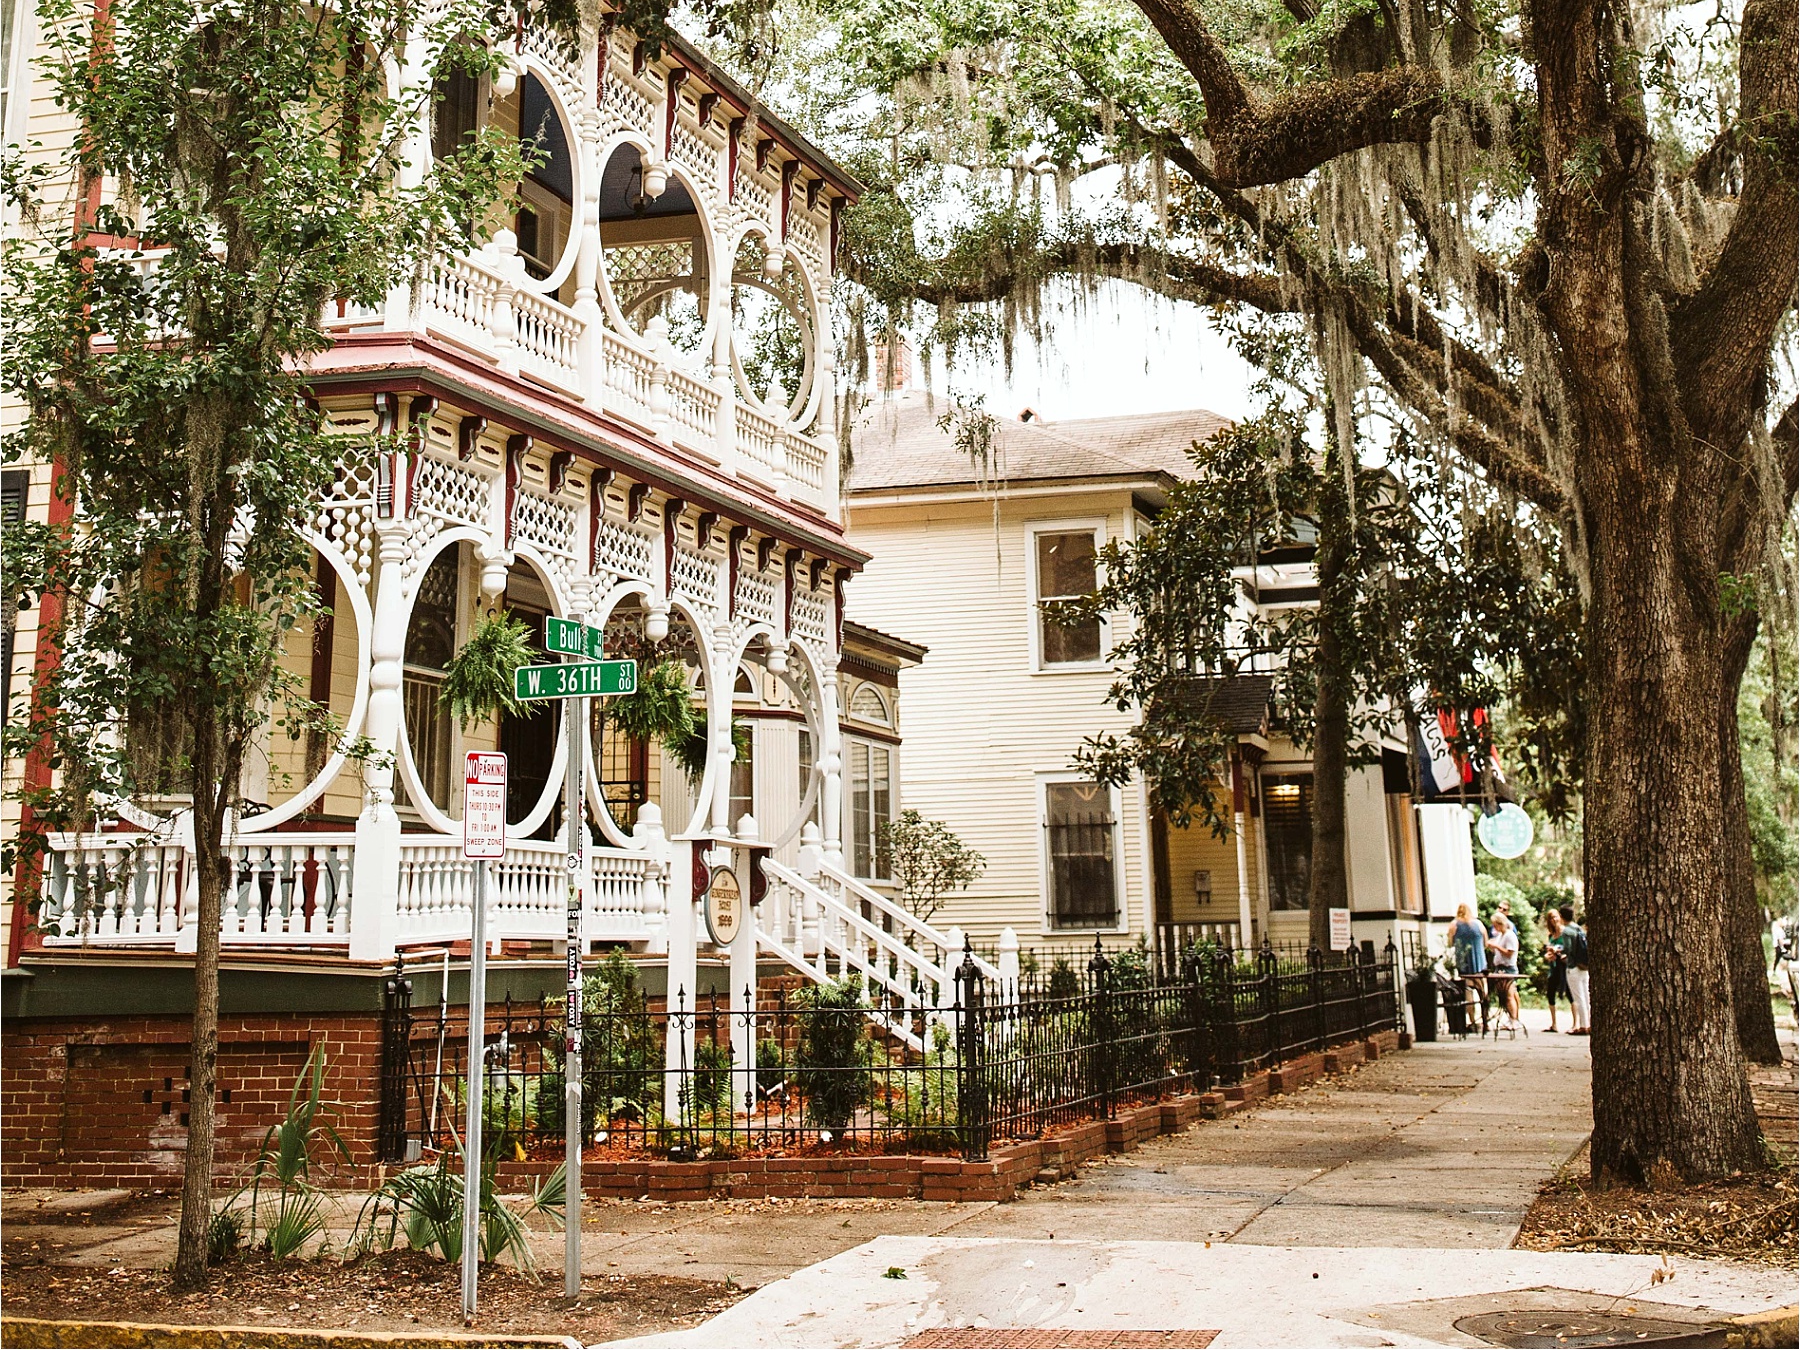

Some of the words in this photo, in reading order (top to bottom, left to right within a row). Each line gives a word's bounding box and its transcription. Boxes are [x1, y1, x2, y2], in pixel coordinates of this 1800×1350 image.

[560, 623, 581, 651] Bull
[620, 663, 631, 678] ST
[528, 670, 546, 695] W.
[557, 666, 601, 693] 36TH
[618, 677, 631, 691] 00
[466, 758, 478, 779] NO
[479, 762, 504, 777] PARKING
[472, 789, 484, 797] THIS
[487, 789, 499, 798] SIDE
[469, 801, 482, 811] THURS
[481, 812, 487, 822] TO
[471, 823, 479, 832] FRI
[467, 837, 485, 846] SWEEP
[487, 838, 502, 846] ZONE
[568, 1002, 576, 1026] FOXY
